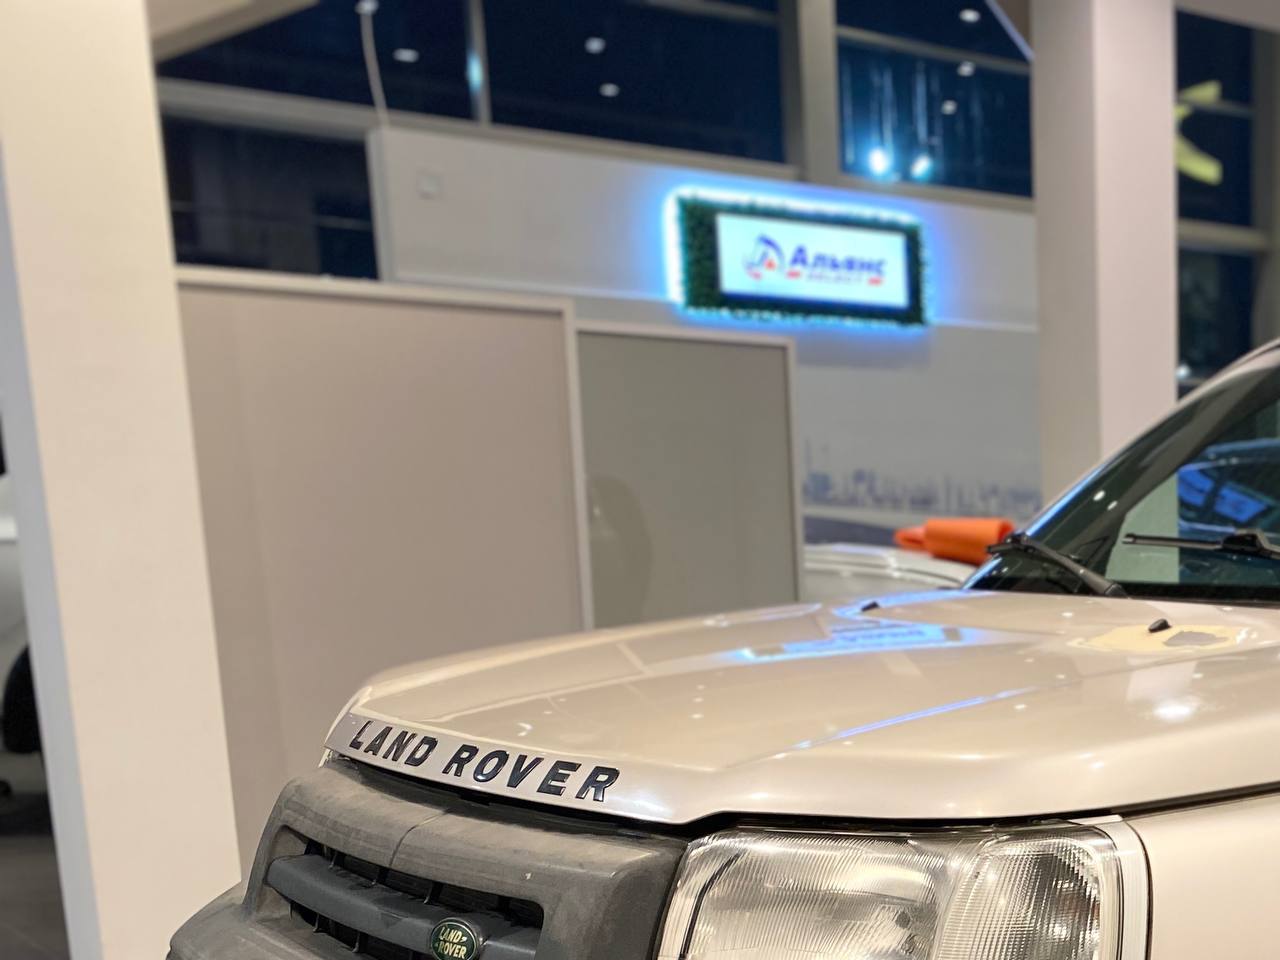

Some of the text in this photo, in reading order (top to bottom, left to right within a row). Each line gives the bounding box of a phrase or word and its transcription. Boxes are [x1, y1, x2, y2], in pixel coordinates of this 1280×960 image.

[349, 720, 620, 802] LAND ROVER
[439, 926, 463, 943] LAND
[438, 941, 467, 960] ROVER
